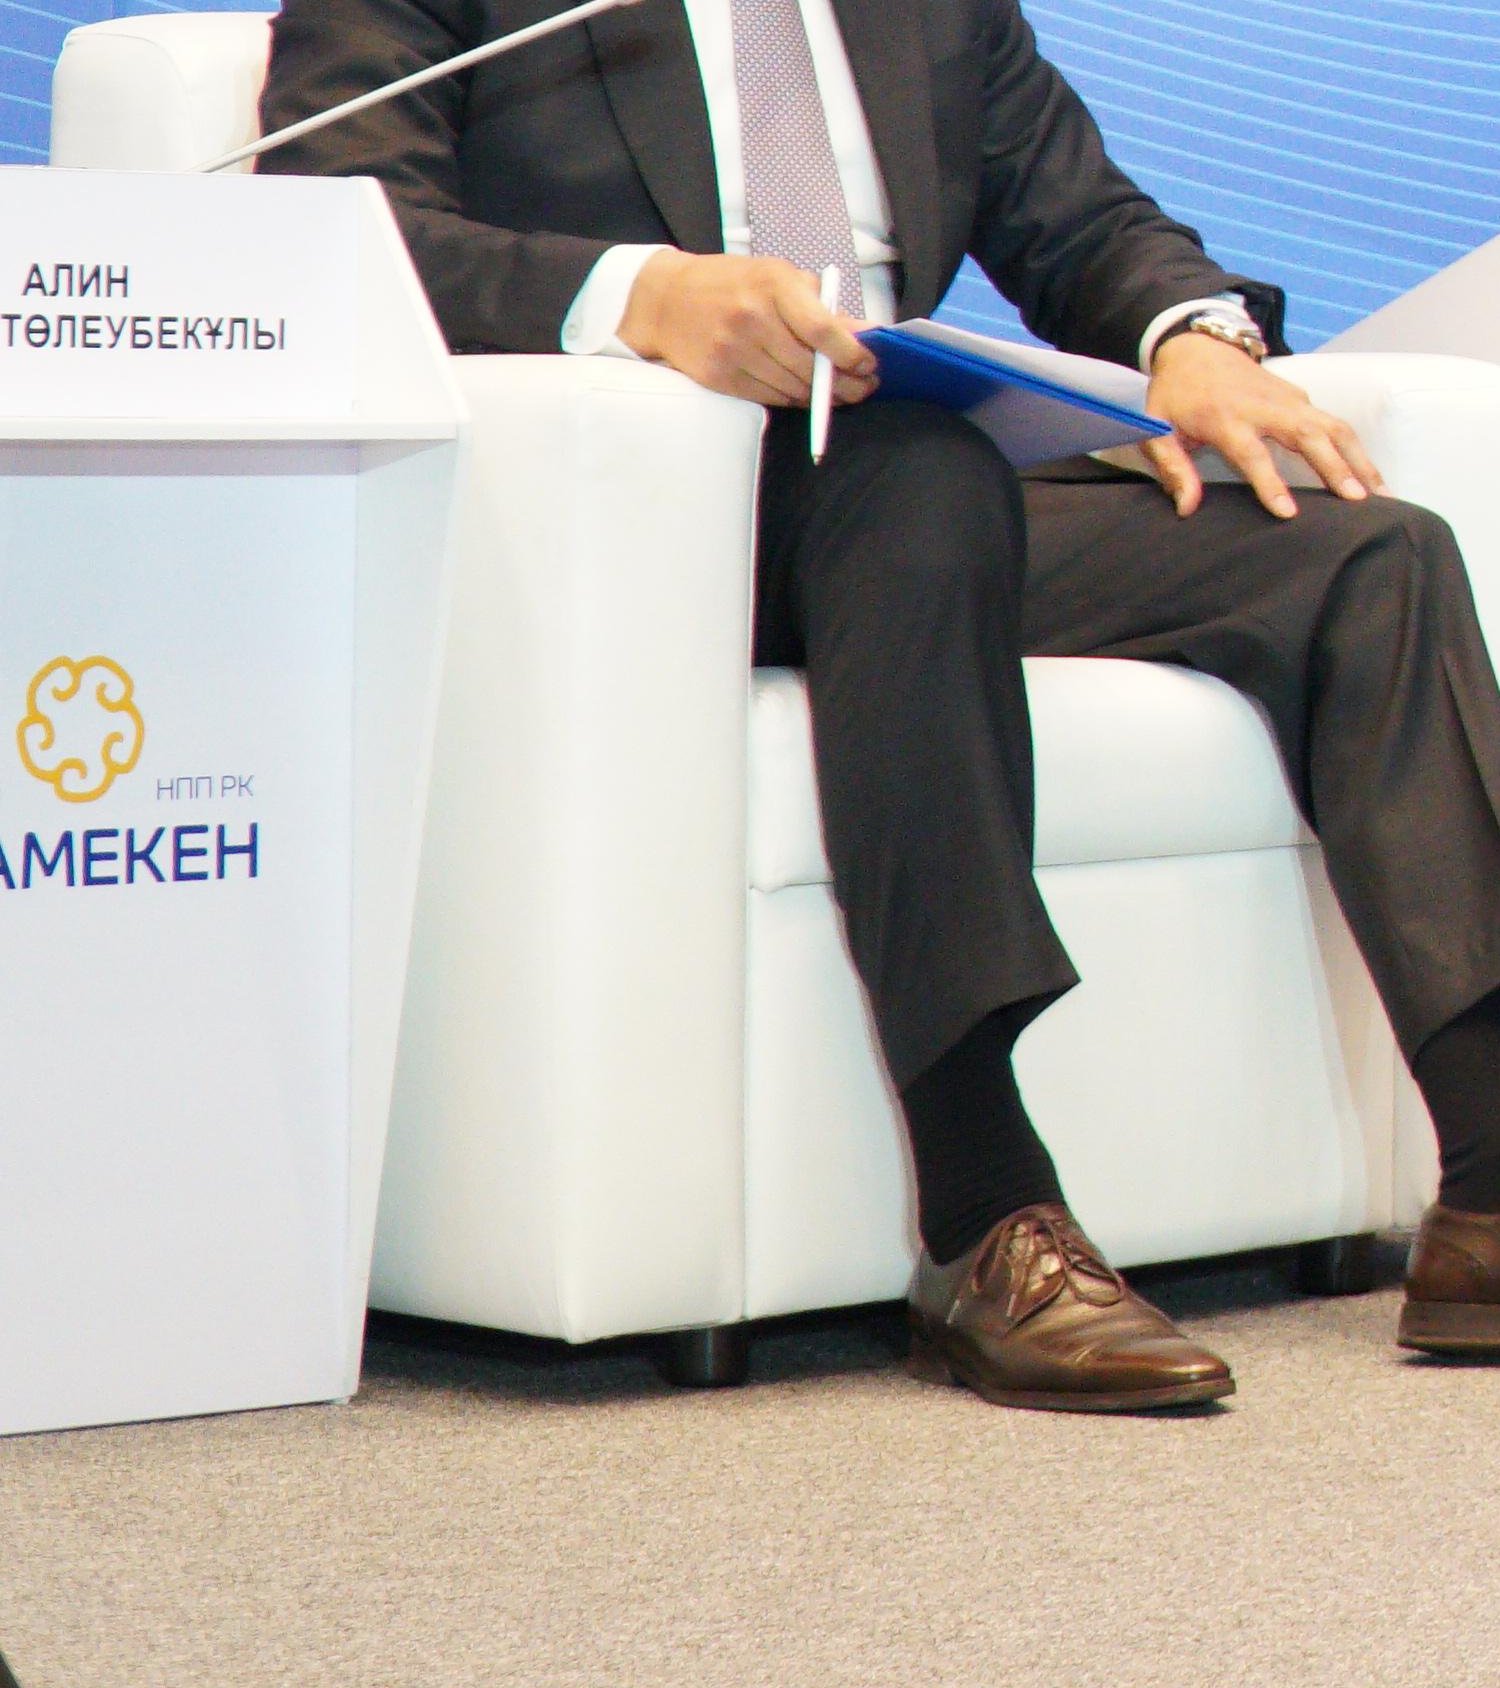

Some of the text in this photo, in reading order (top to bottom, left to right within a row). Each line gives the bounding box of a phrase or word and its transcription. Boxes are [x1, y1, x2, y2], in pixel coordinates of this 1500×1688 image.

[21, 263, 129, 298] АЛИН
[0, 313, 286, 351] ТӨЛЕУБЕКҰЛЫ
[155, 773, 255, 801] НПП РК
